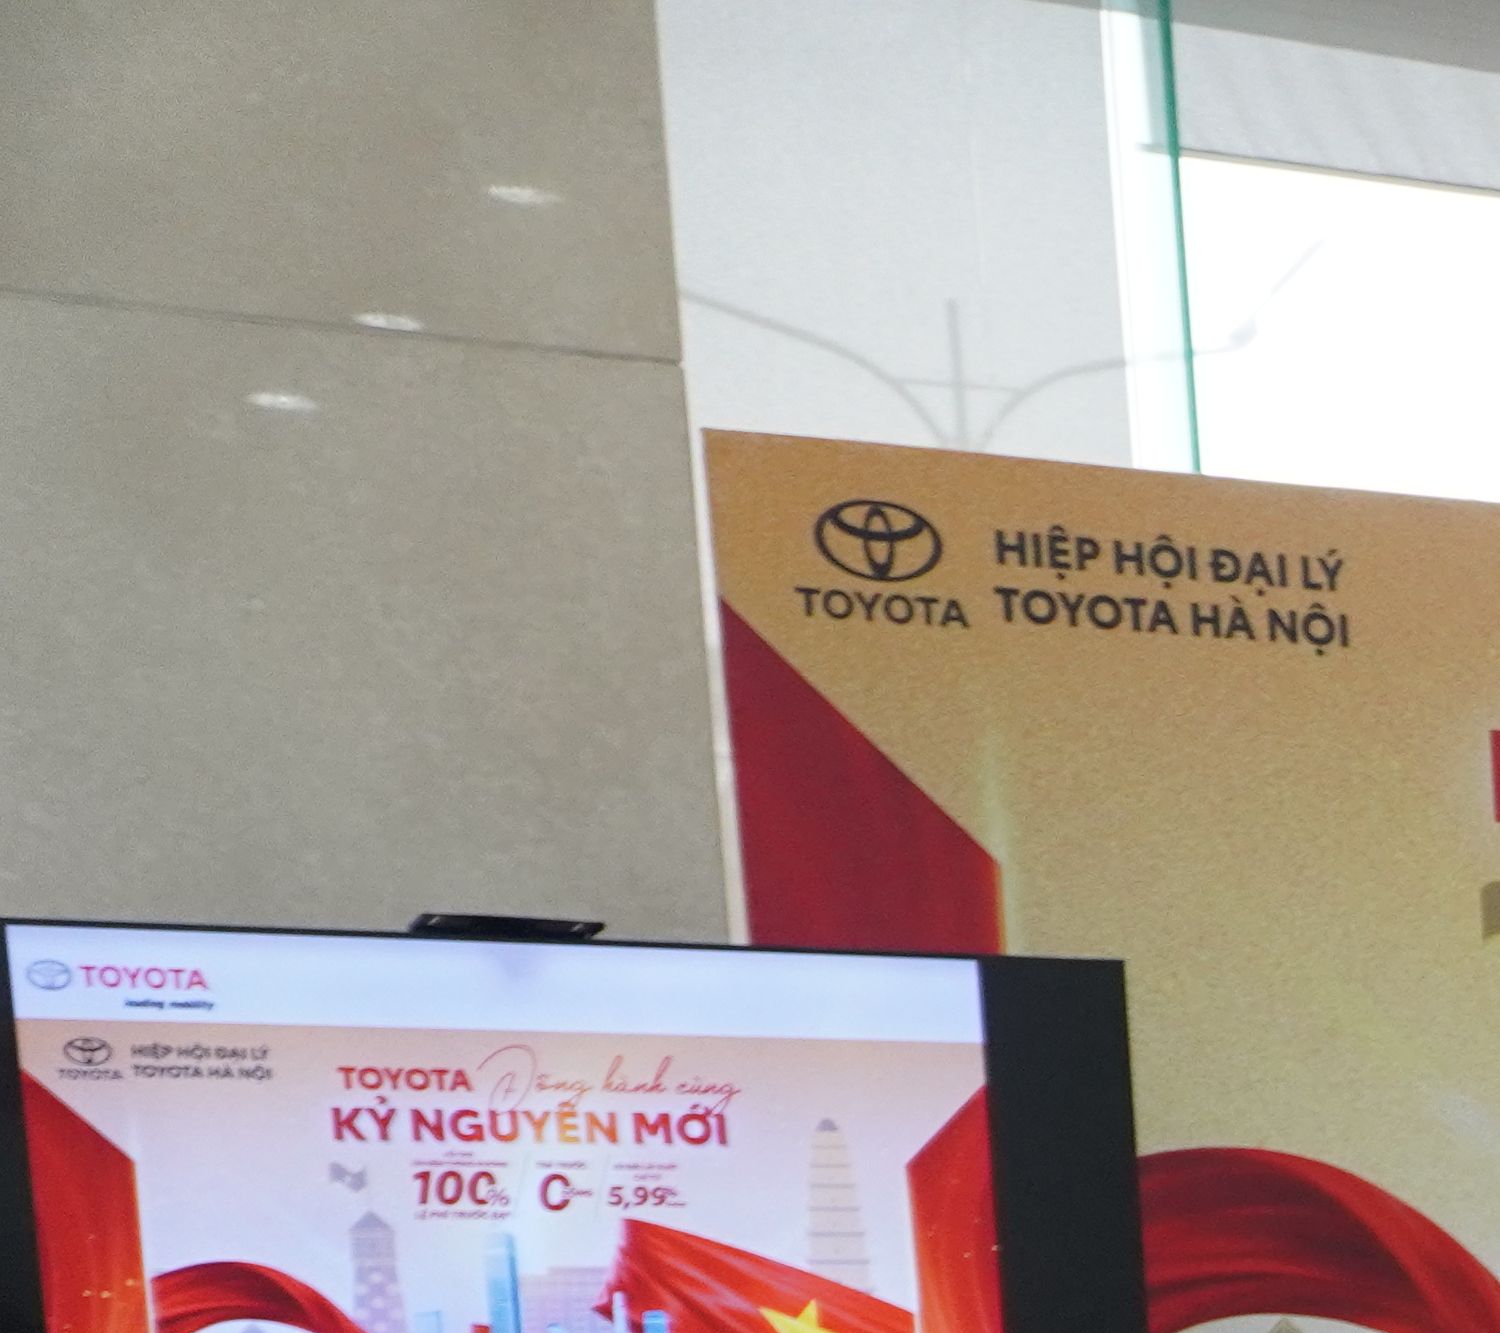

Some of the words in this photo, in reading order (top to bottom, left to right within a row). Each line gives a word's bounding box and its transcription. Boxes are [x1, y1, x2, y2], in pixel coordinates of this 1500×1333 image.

[995, 526, 1100, 579] HIỆP
[1114, 534, 1197, 588] HỘI
[1210, 549, 1288, 596] ĐẠI
[1302, 549, 1343, 592] LÝ
[795, 586, 970, 629] TOYOTA
[994, 587, 1179, 635] TOYOTA
[1191, 597, 1255, 640] HÀ
[1267, 603, 1350, 655] NỘI
[79, 965, 210, 991] TOYOTA
[130, 1063, 202, 1080] TOYOTA
[337, 1066, 473, 1093] TOYOTA
[331, 1095, 396, 1143] KỶ
[410, 1101, 619, 1145] NGUYÊN
[633, 1102, 729, 1148] MỚI
